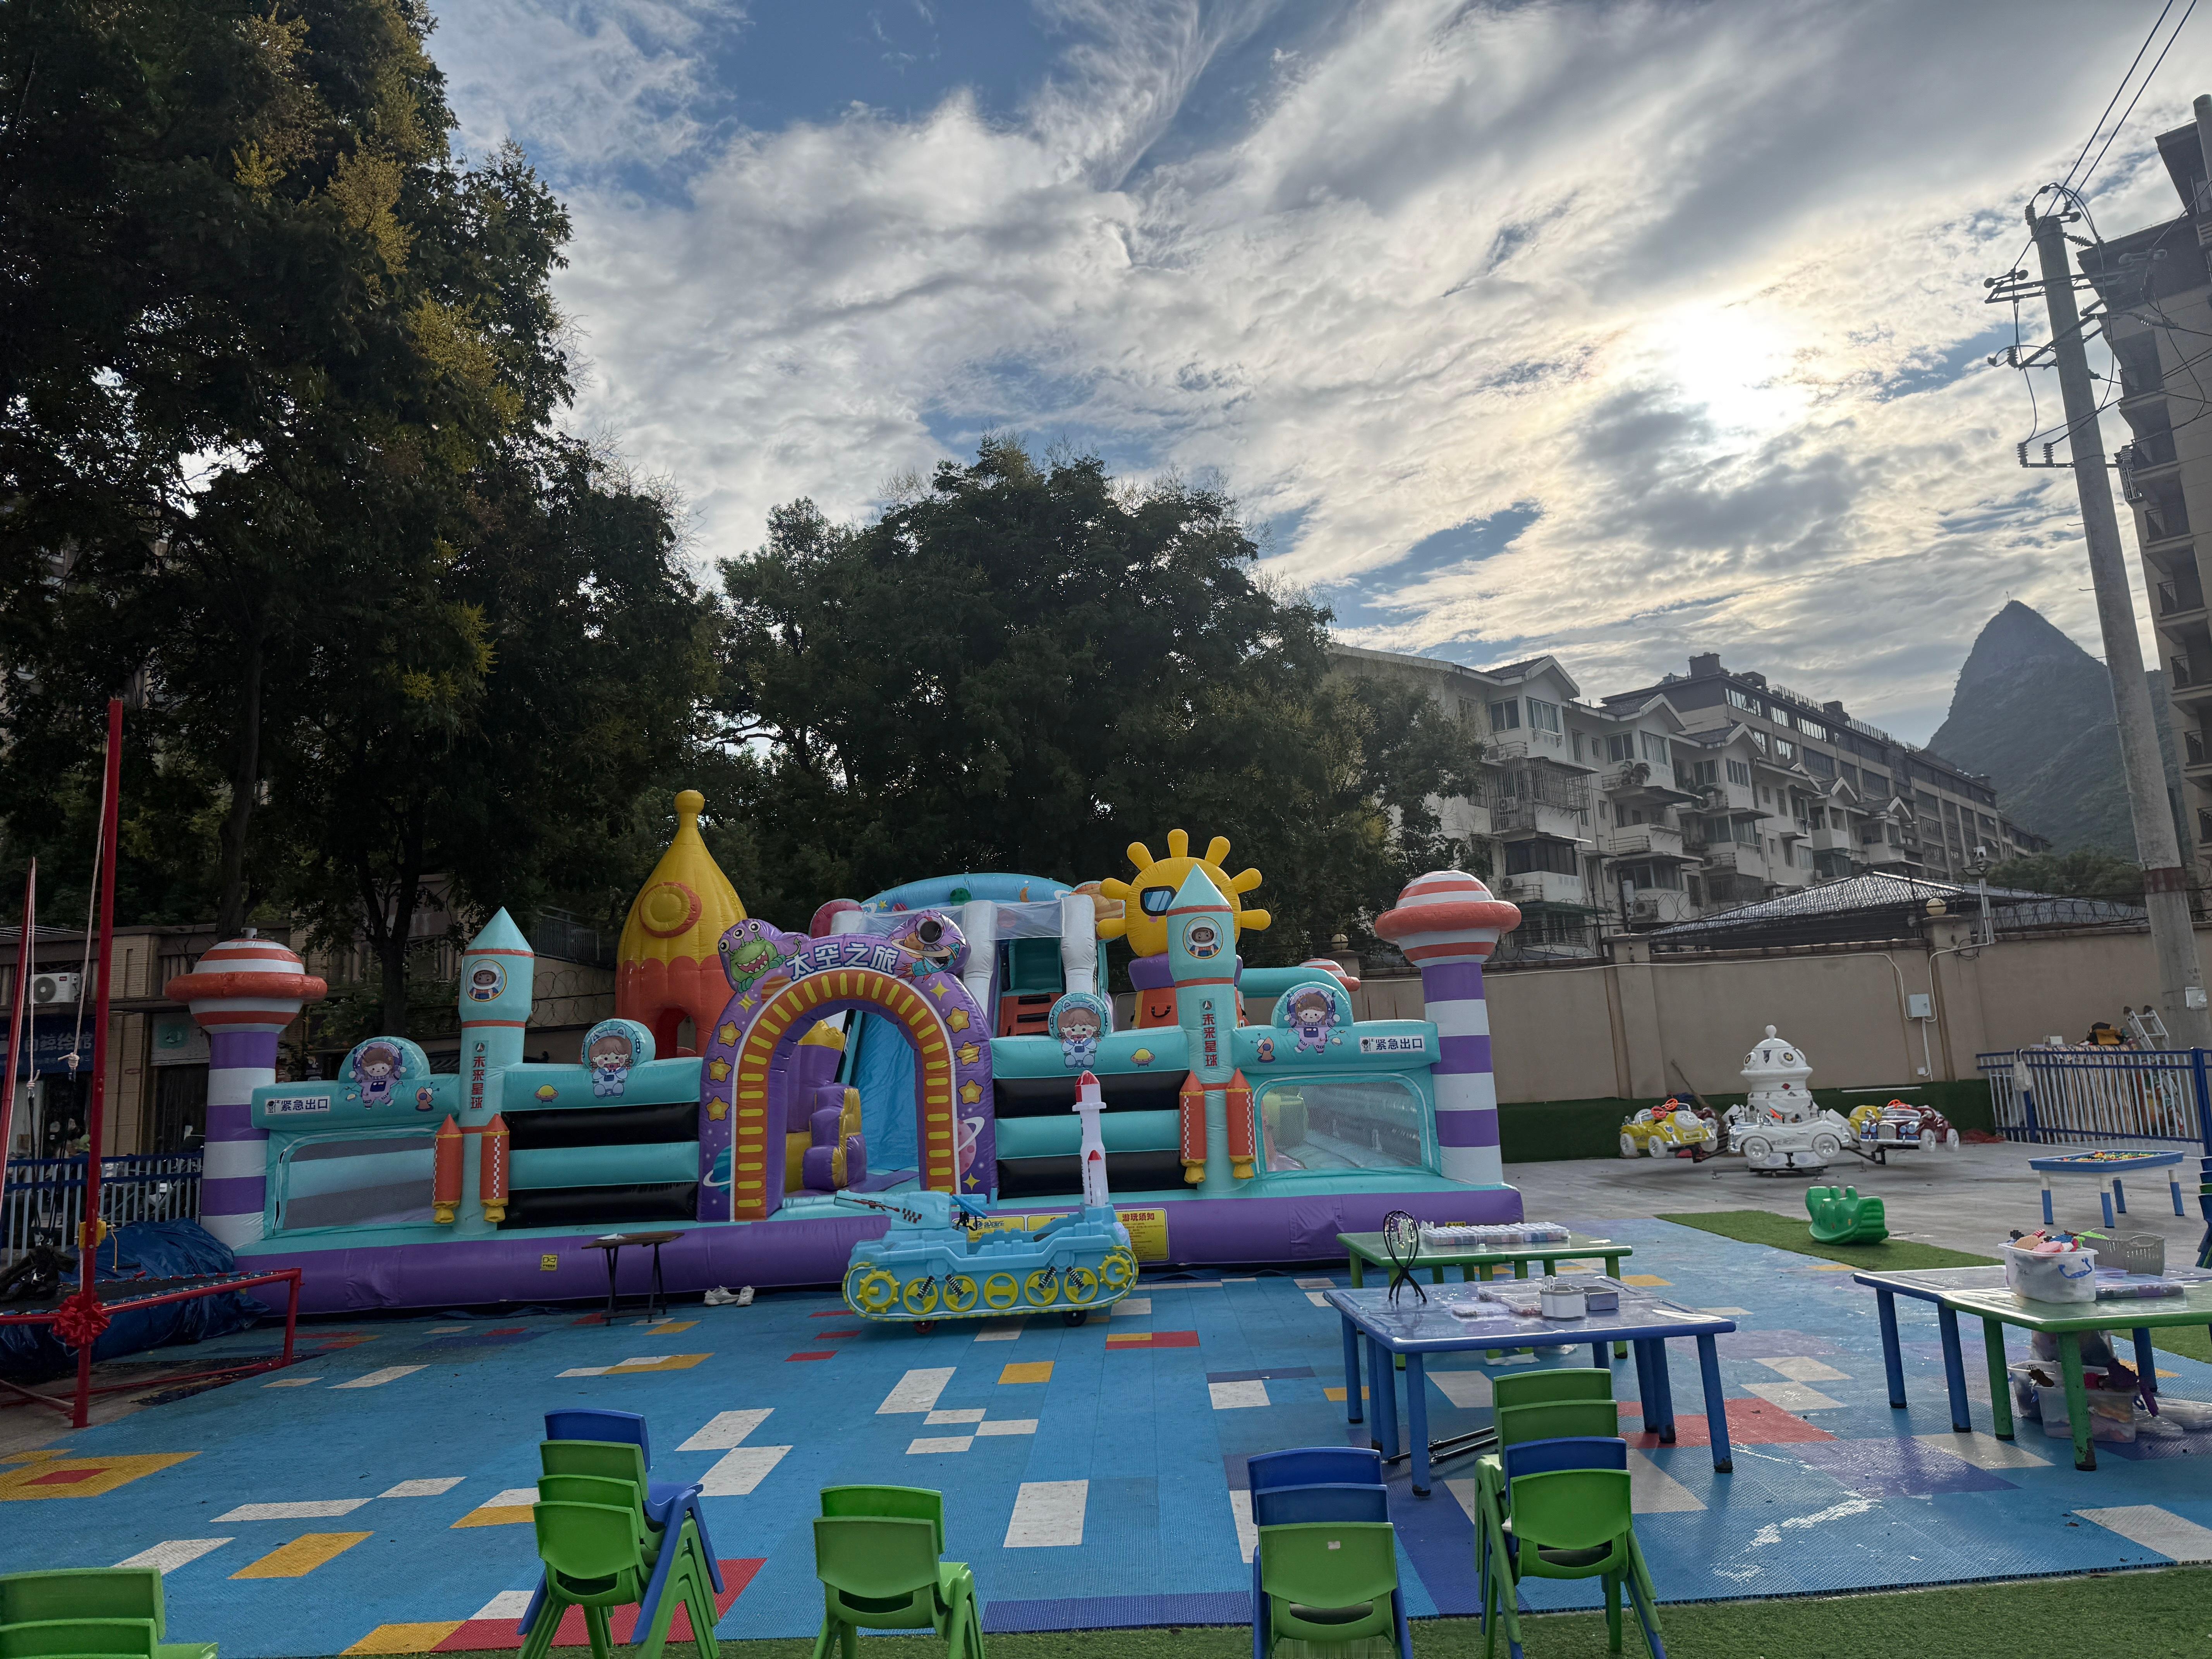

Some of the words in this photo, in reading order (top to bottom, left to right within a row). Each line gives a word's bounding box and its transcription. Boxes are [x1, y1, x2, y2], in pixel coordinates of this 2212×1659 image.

[785, 942, 900, 981] 太空之旅
[1202, 1013, 1218, 1066] 未来星球
[1376, 1038, 1423, 1050] 紧急出口
[471, 1055, 486, 1109] 未来星球
[281, 1099, 328, 1111] 紧急出口
[1122, 1212, 1155, 1222] 游玩须知
